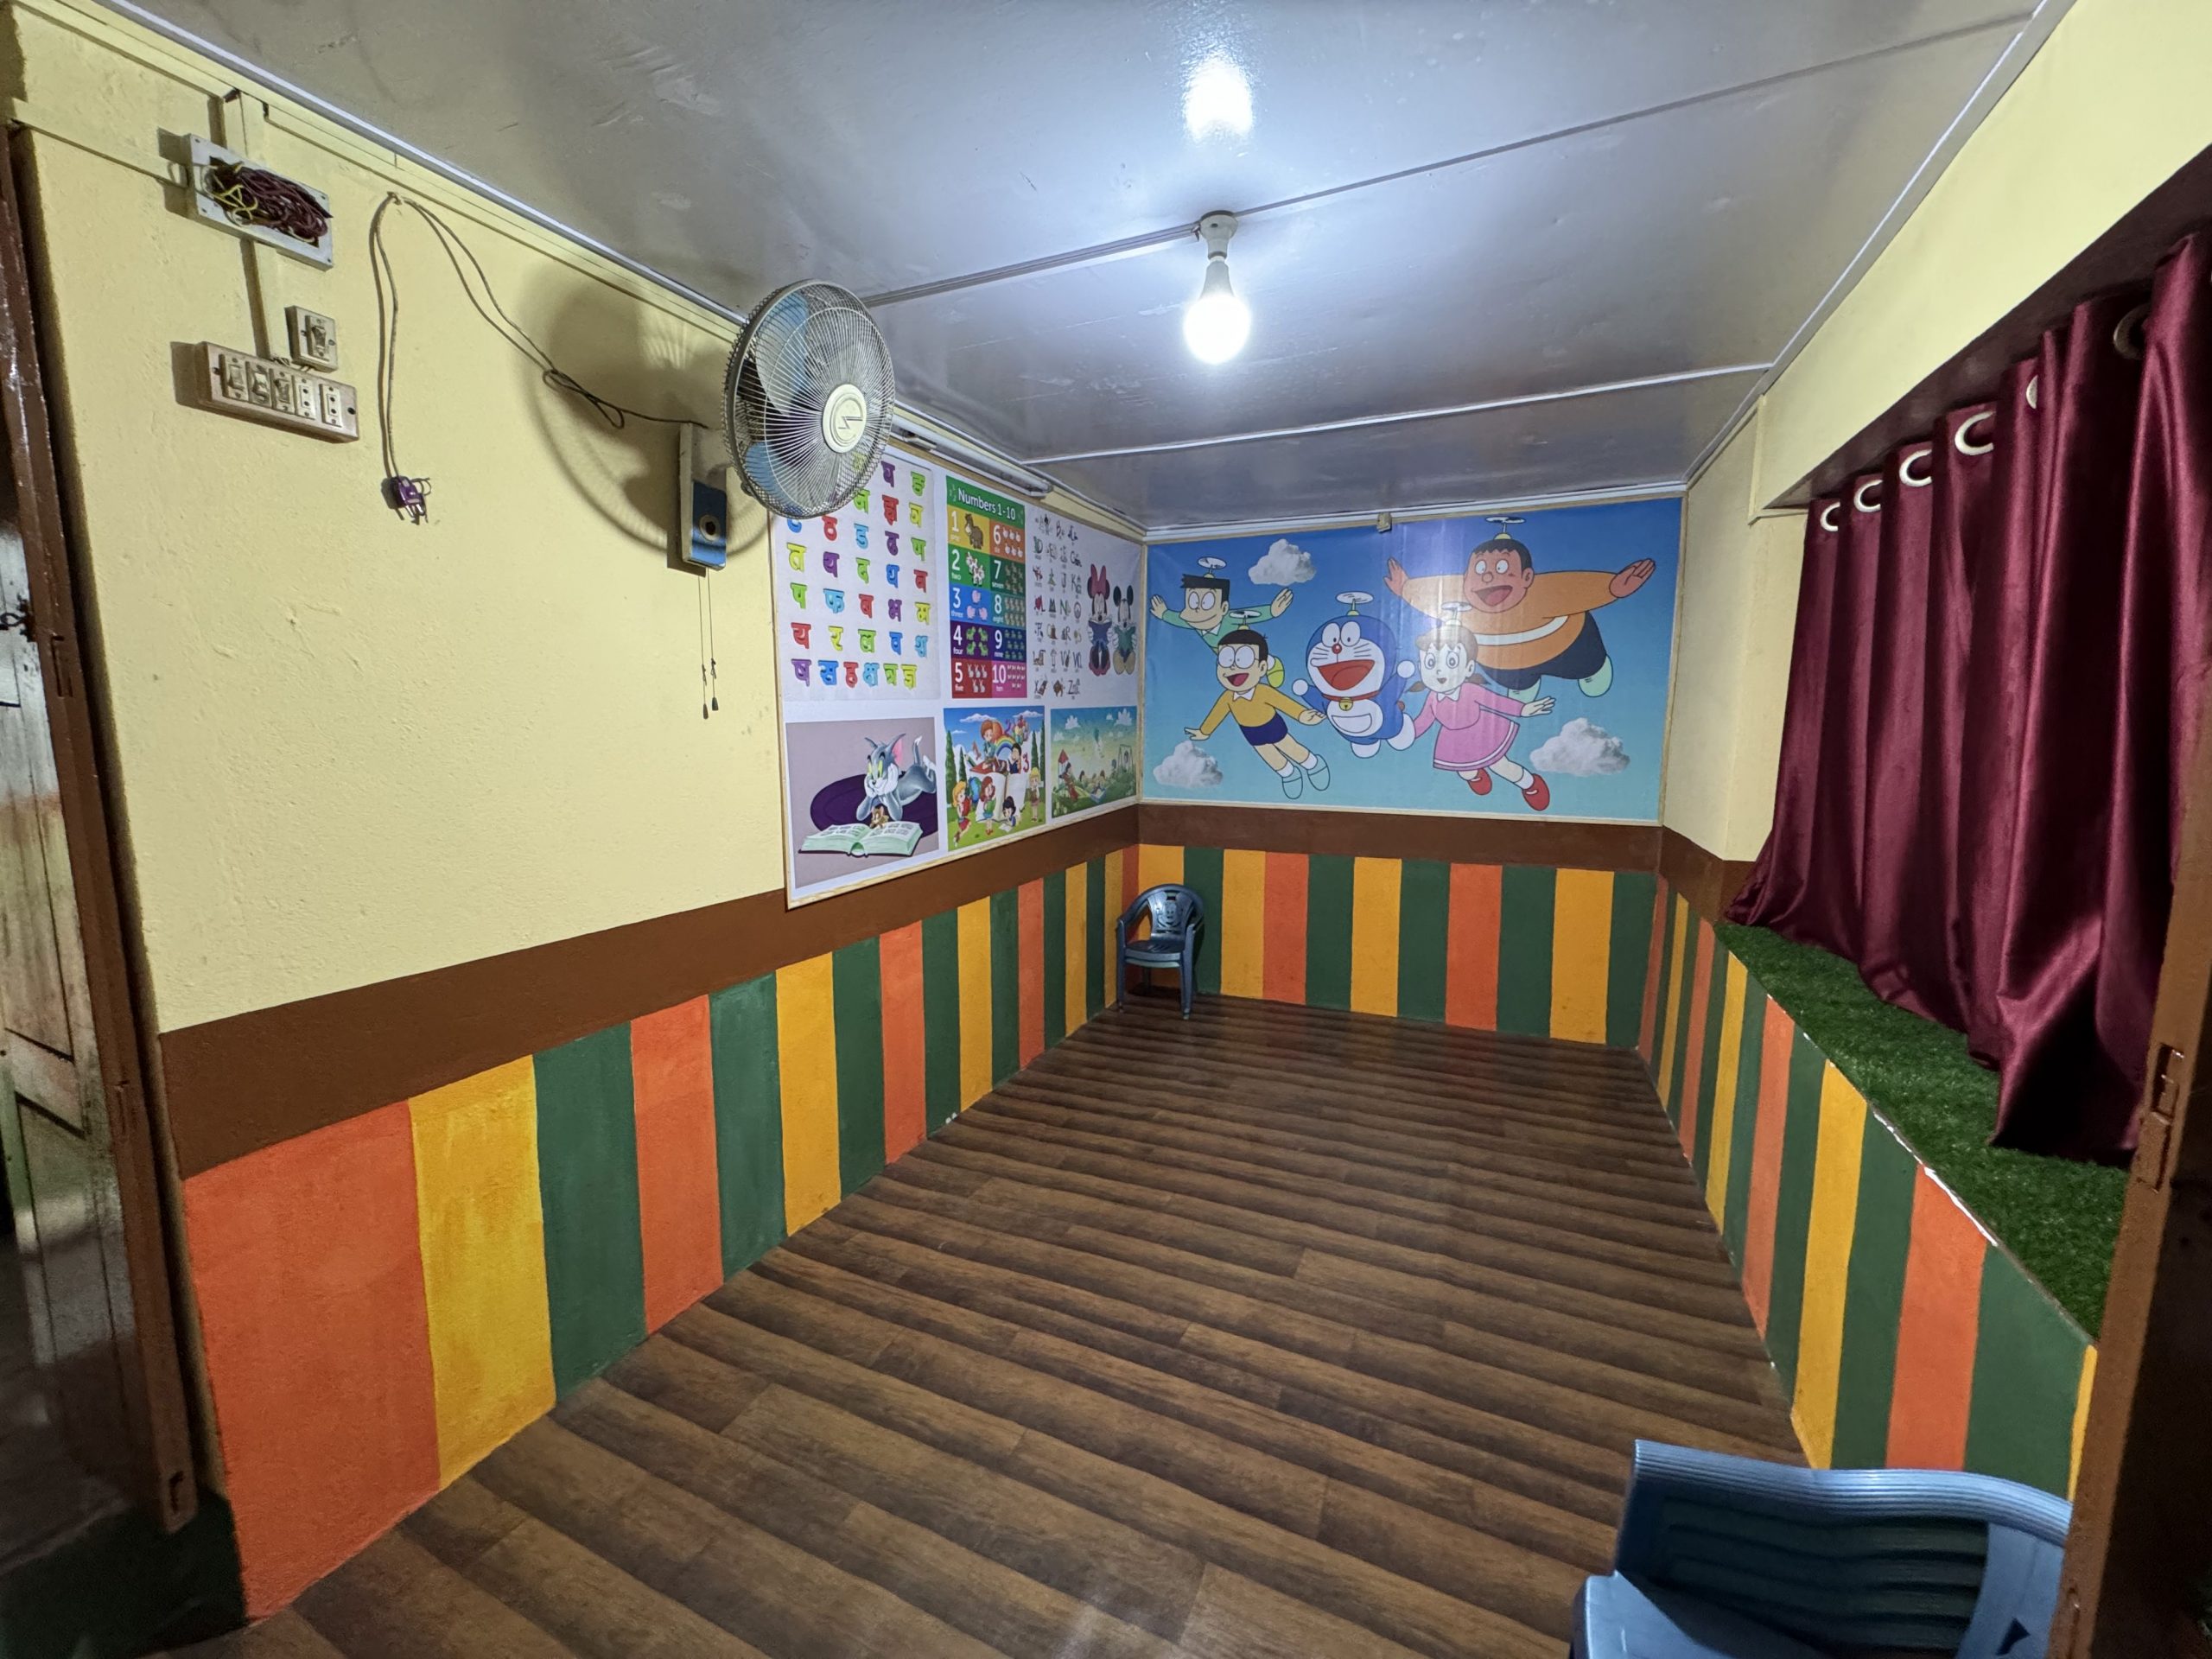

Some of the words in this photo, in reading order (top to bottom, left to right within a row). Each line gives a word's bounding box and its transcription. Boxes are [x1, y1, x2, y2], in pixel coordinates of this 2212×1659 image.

[880, 461, 895, 487] घ
[958, 487, 996, 513] Numbers
[951, 511, 959, 532] 1
[854, 523, 868, 549] ड
[885, 531, 899, 556] ढ
[993, 524, 1001, 544] 6
[786, 542, 807, 572] त
[855, 557, 870, 583] द
[913, 569, 928, 593] न
[951, 549, 961, 571] 2
[994, 559, 1001, 580] 7
[790, 582, 807, 609] प
[823, 588, 845, 613] फ
[952, 587, 961, 608] 3
[995, 594, 1002, 614] 8
[791, 622, 811, 649] य
[828, 626, 843, 652] र
[858, 628, 876, 653] ल
[953, 625, 963, 645] 4
[995, 630, 1002, 650] 9
[955, 662, 963, 683] 5
[992, 664, 1007, 683] 10
